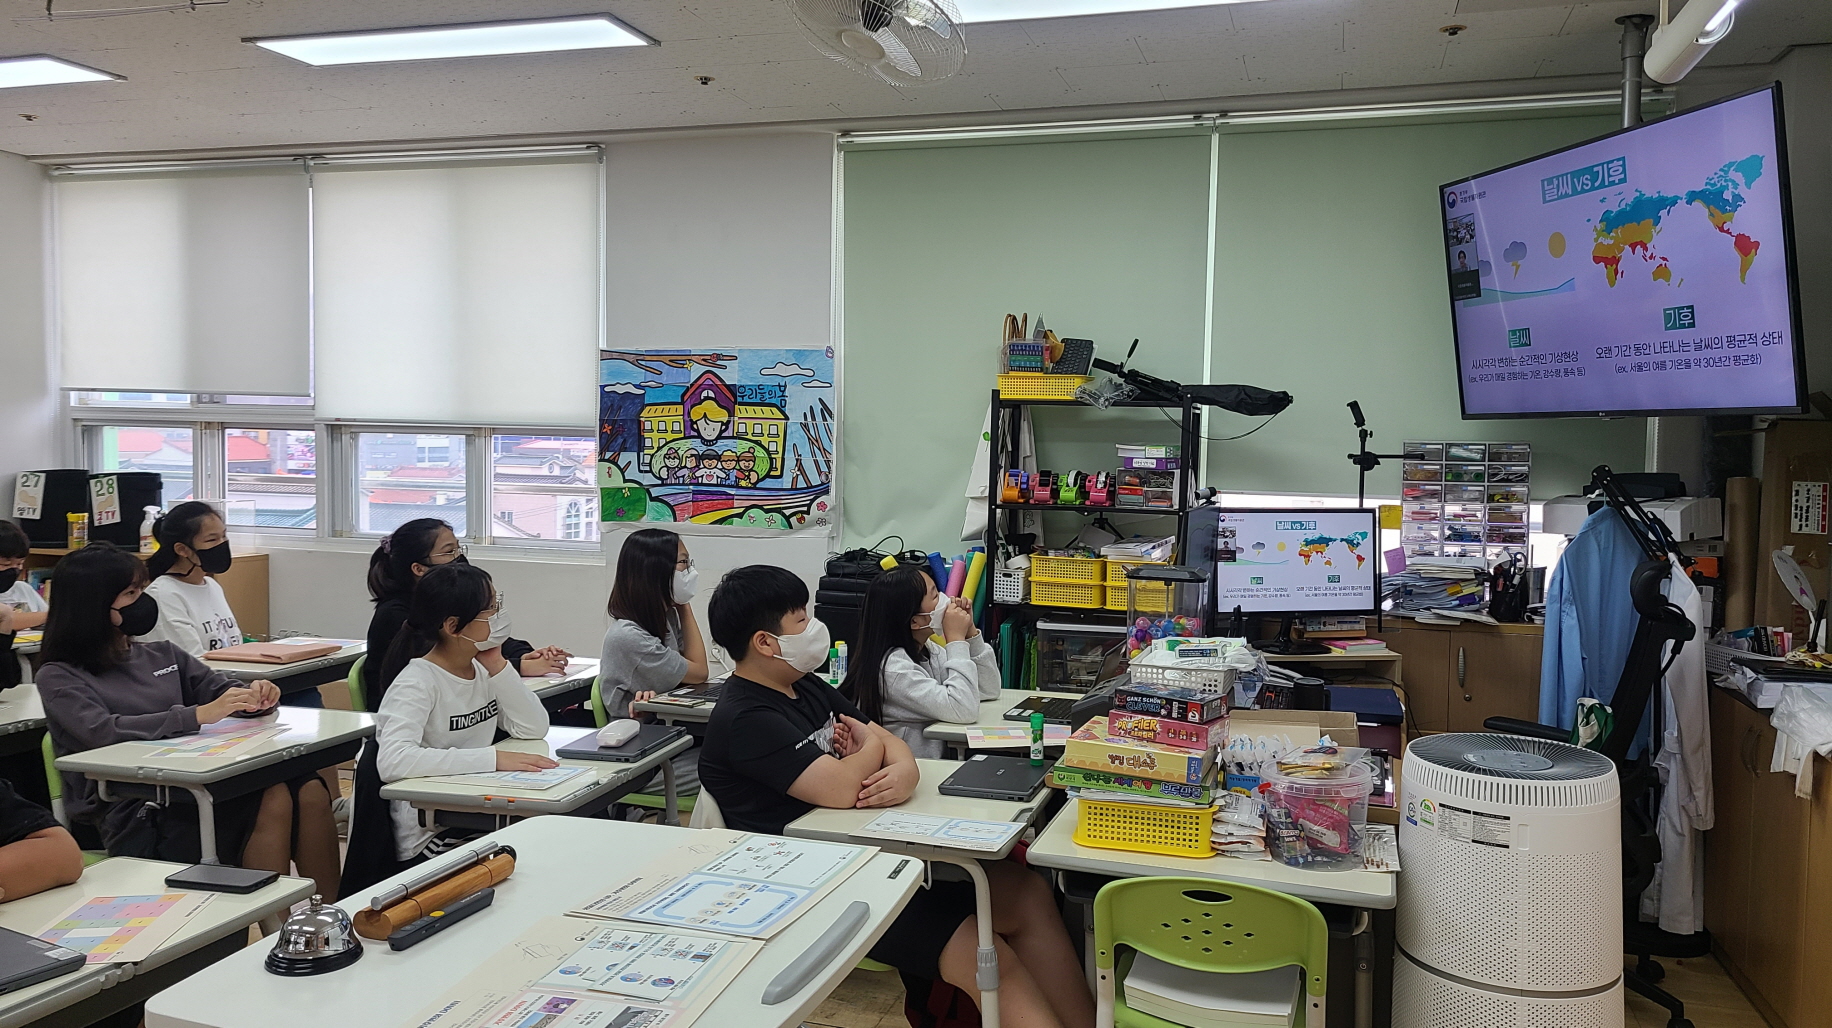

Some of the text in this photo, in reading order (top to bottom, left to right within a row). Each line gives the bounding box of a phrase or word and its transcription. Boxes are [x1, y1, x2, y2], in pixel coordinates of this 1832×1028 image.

[1544, 174, 1571, 201] 날씨
[1593, 160, 1625, 188] 기후
[1666, 307, 1694, 328] 기후
[1509, 329, 1530, 347] 날씨
[1596, 330, 1784, 359] 오랜 기간 동안 나타나는 날씨의 평균적 상태
[1471, 350, 1579, 370] 시시각각 변하는 순간적인 기상현상
[1629, 361, 1651, 373] 서울의
[1652, 360, 1667, 371] 여름
[1668, 358, 1692, 370] 기온을
[1693, 357, 1701, 369] 약
[1702, 355, 1731, 369] 30년간
[1732, 352, 1762, 367] 평균화)
[738, 381, 789, 408] 우리들의 봄
[20, 473, 41, 488] 27
[94, 478, 115, 497] 28
[1276, 521, 1291, 530] 날씨
[1301, 521, 1316, 530] 기후
[1125, 702, 1161, 713] CLEVER
